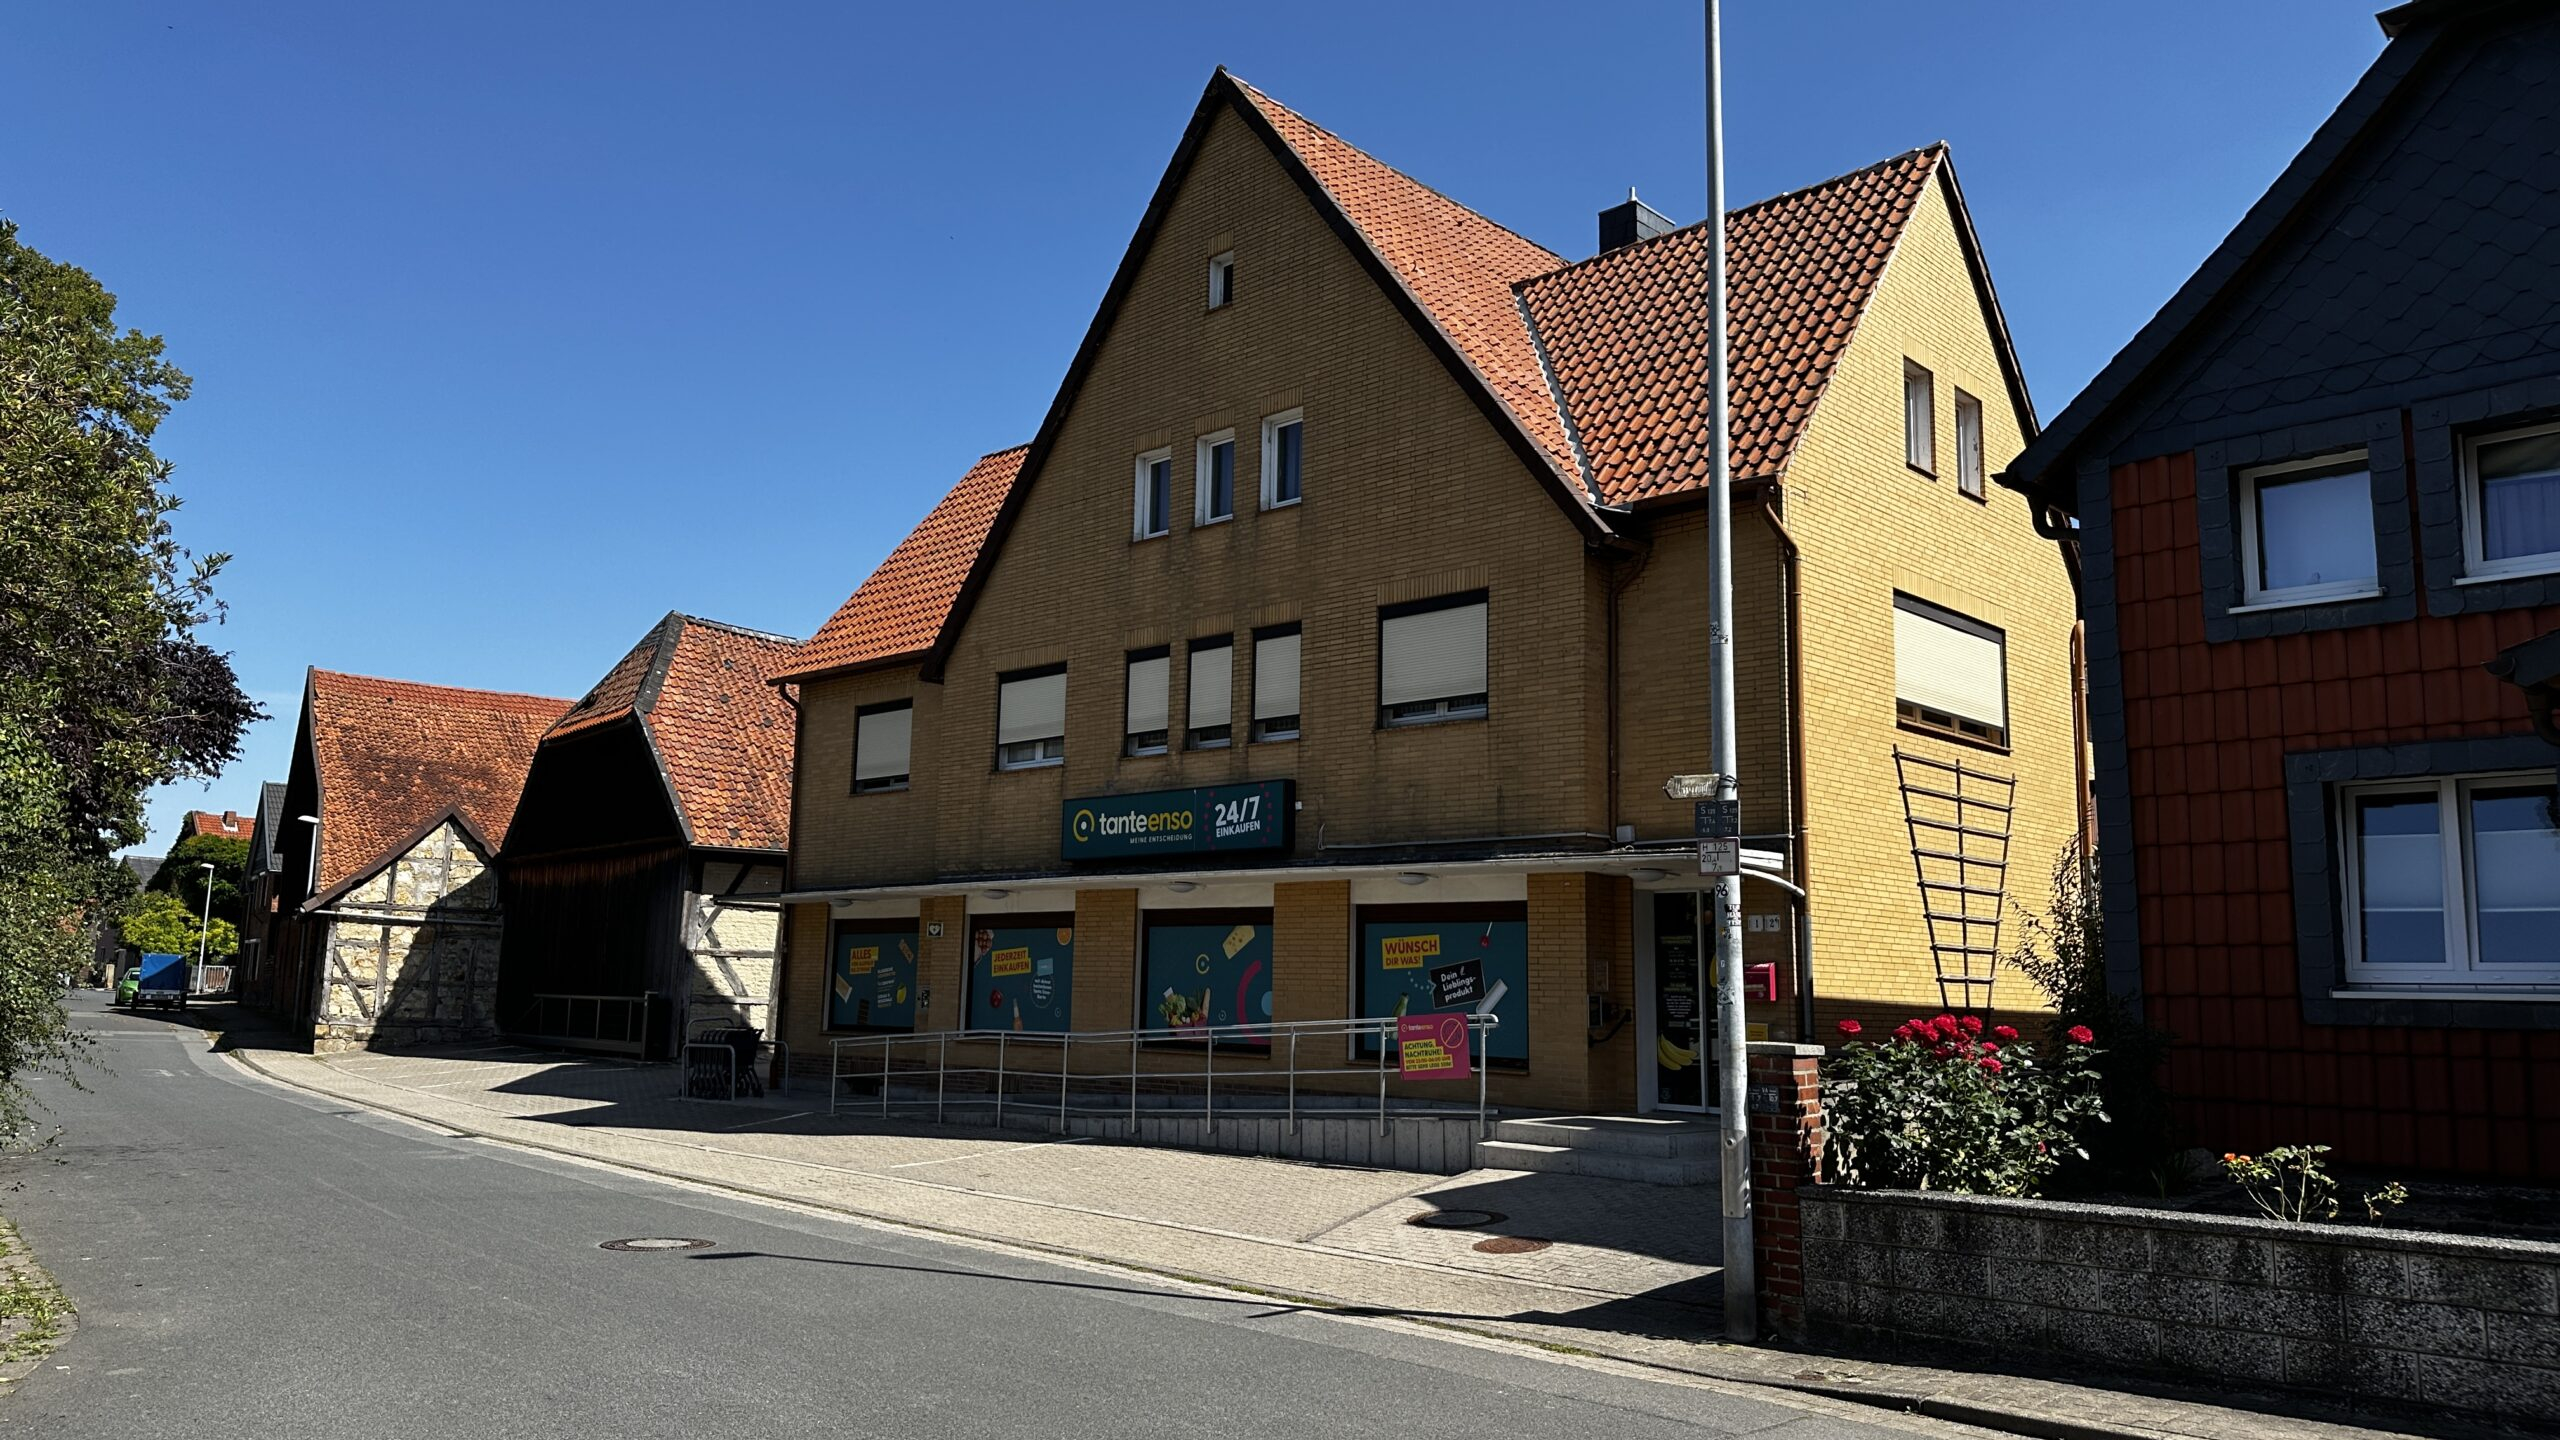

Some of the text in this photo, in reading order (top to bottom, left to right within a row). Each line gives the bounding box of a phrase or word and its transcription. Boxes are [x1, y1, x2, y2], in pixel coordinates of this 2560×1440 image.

[1214, 795, 1260, 827] 24/7
[1099, 810, 1193, 835] tanteenso
[1216, 820, 1260, 838] EINKAUFEN
[1130, 833, 1193, 844] MEINE ENTSCHEIDUNG
[1714, 842, 1728, 851] 125
[1715, 884, 1728, 897] 96
[1385, 939, 1437, 955] WÜNSCH
[852, 949, 872, 960] ALLES
[994, 950, 1027, 962] JEDERZEIT
[1386, 955, 1421, 966] DIR WAS!
[994, 961, 1030, 974] EINKAUFEN
[1440, 972, 1457, 983] Dein
[1442, 976, 1476, 992] Lieblings-
[1445, 986, 1473, 1003] produkt
[1404, 1041, 1435, 1050] ACHTUNG,
[1405, 1048, 1443, 1058] NACHTRUHE!
